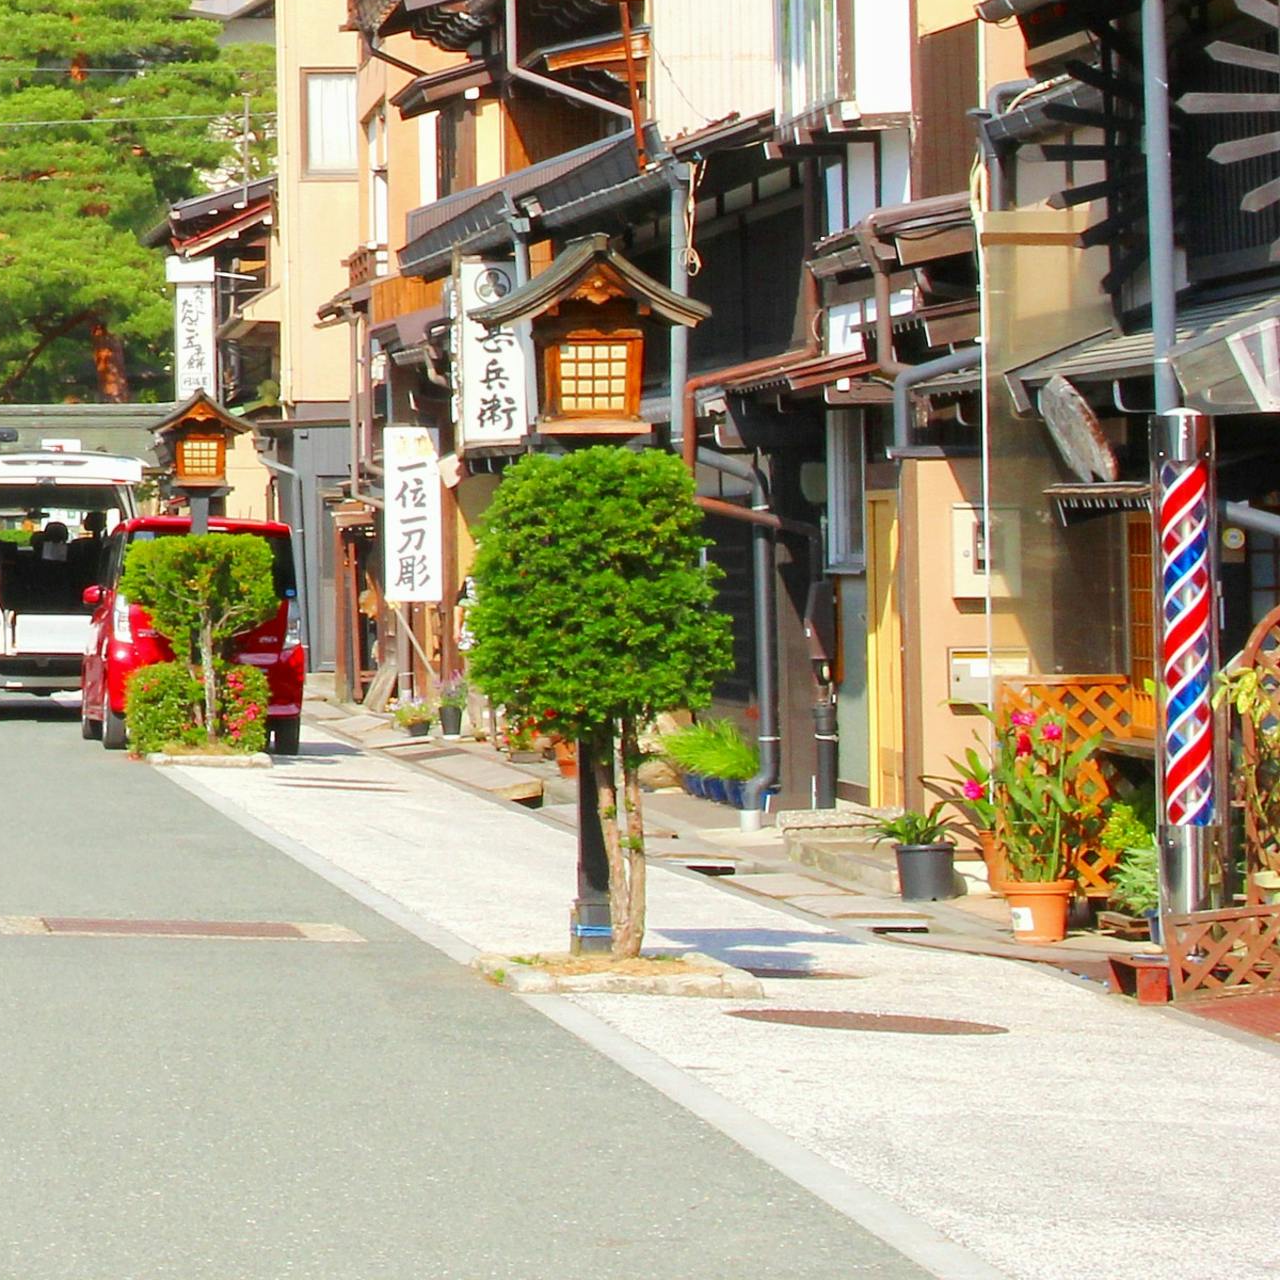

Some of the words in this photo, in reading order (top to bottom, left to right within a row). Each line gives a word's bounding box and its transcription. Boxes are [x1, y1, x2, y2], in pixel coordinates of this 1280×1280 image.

[395, 461, 431, 592] 一位一刀彫
